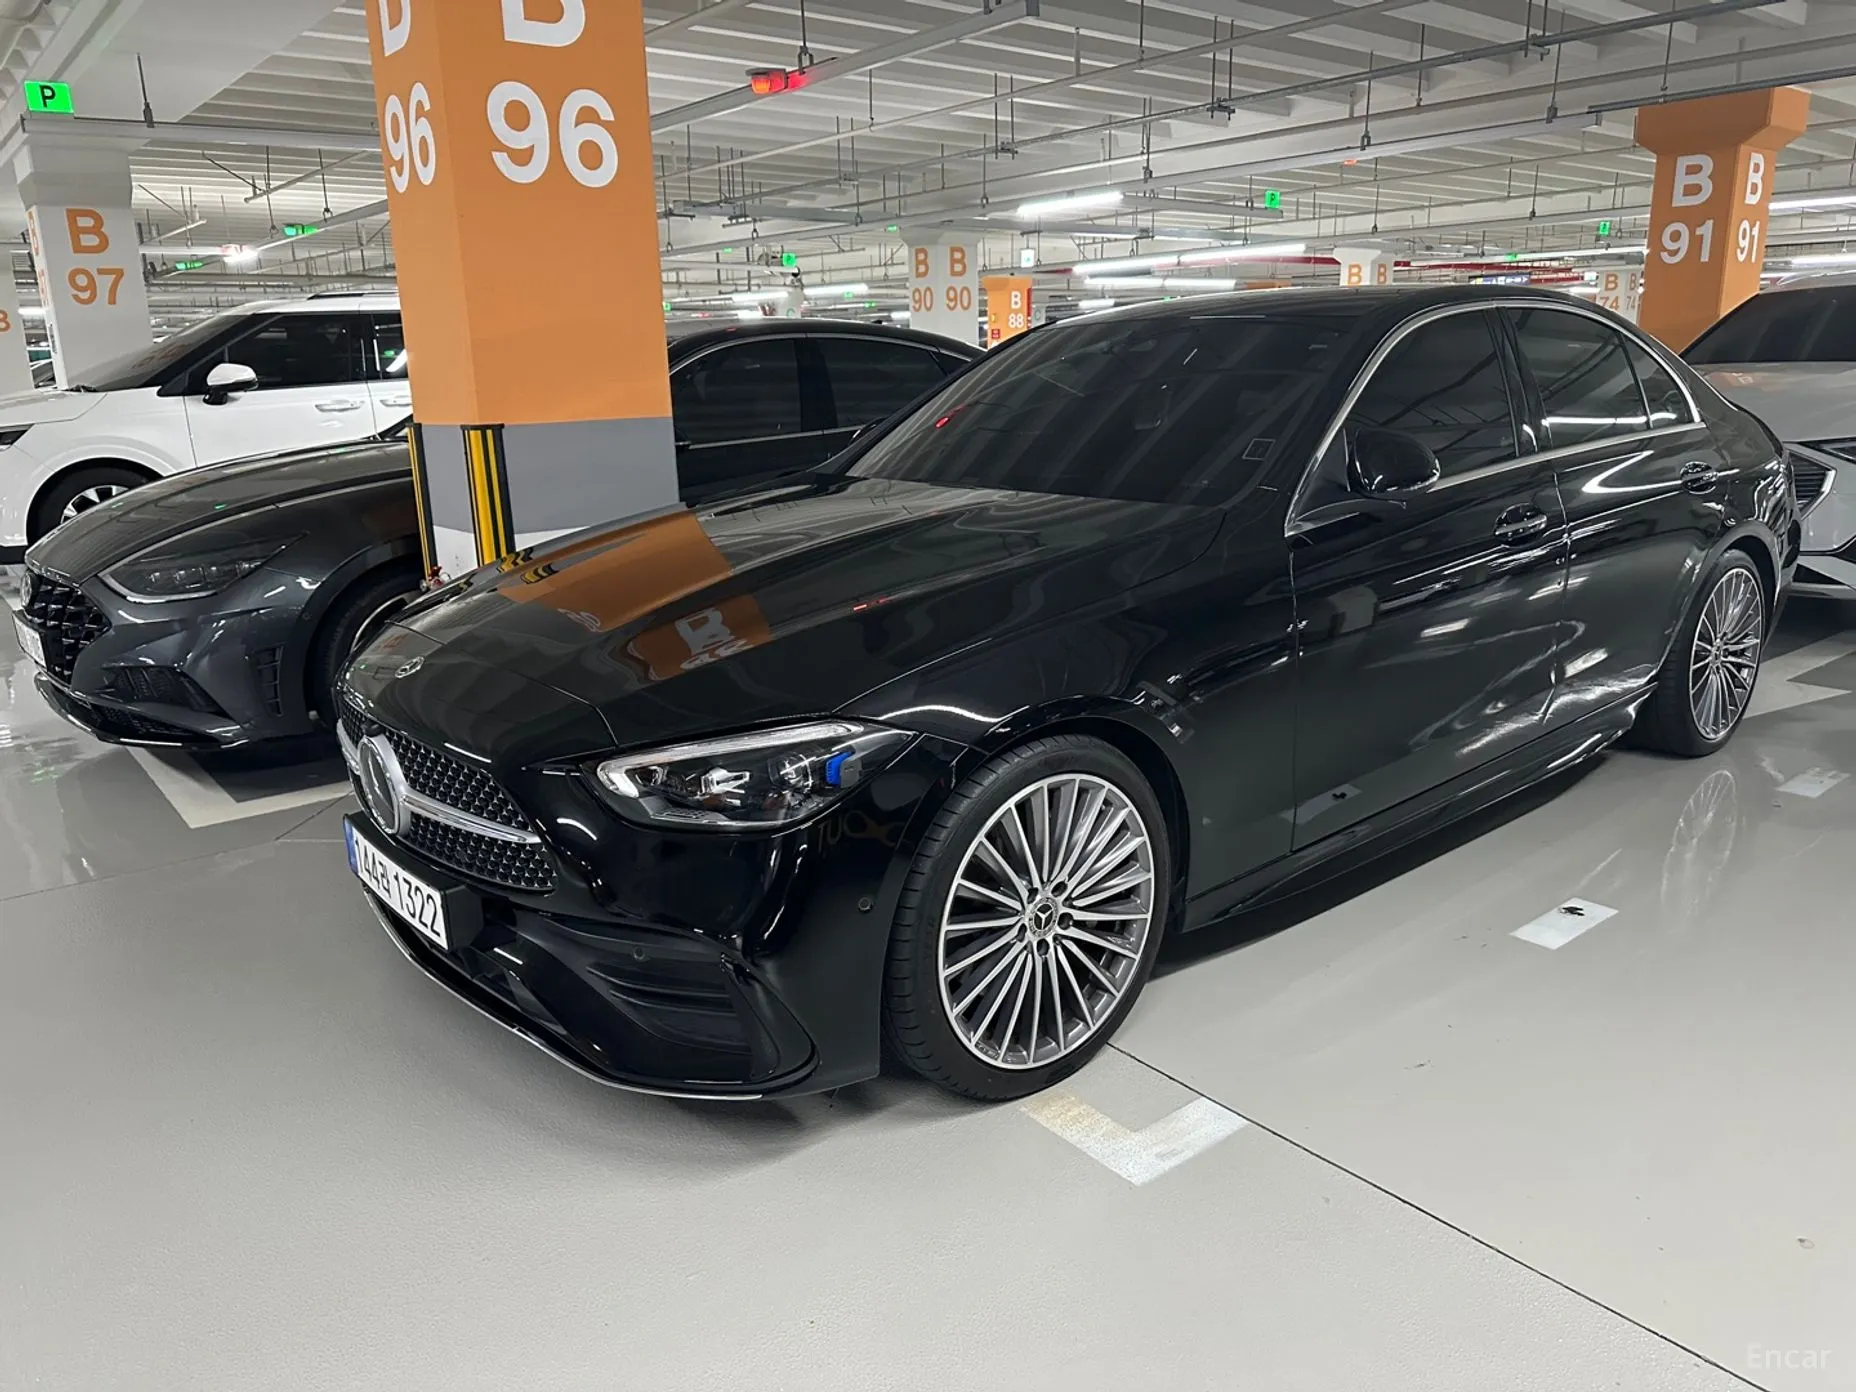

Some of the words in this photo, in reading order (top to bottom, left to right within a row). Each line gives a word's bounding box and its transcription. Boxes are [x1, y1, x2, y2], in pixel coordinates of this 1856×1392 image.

[39, 85, 56, 108] P
[385, 82, 436, 193] 96
[487, 81, 618, 188] 96
[1672, 154, 1714, 208] B
[1745, 152, 1765, 205] B
[66, 208, 110, 254] B
[1660, 219, 1714, 264] 91
[1736, 219, 1760, 263] 91
[914, 247, 930, 279] B
[950, 246, 967, 277] B
[1348, 263, 1362, 286] B
[1377, 263, 1387, 285] B
[67, 268, 125, 305] 97
[1604, 273, 1618, 291] B
[912, 286, 934, 312] 90
[946, 285, 972, 311] 90
[1010, 291, 1021, 309] B
[1600, 295, 1619, 311] 74
[1008, 312, 1024, 329] 88
[394, 871, 441, 938] 1322
